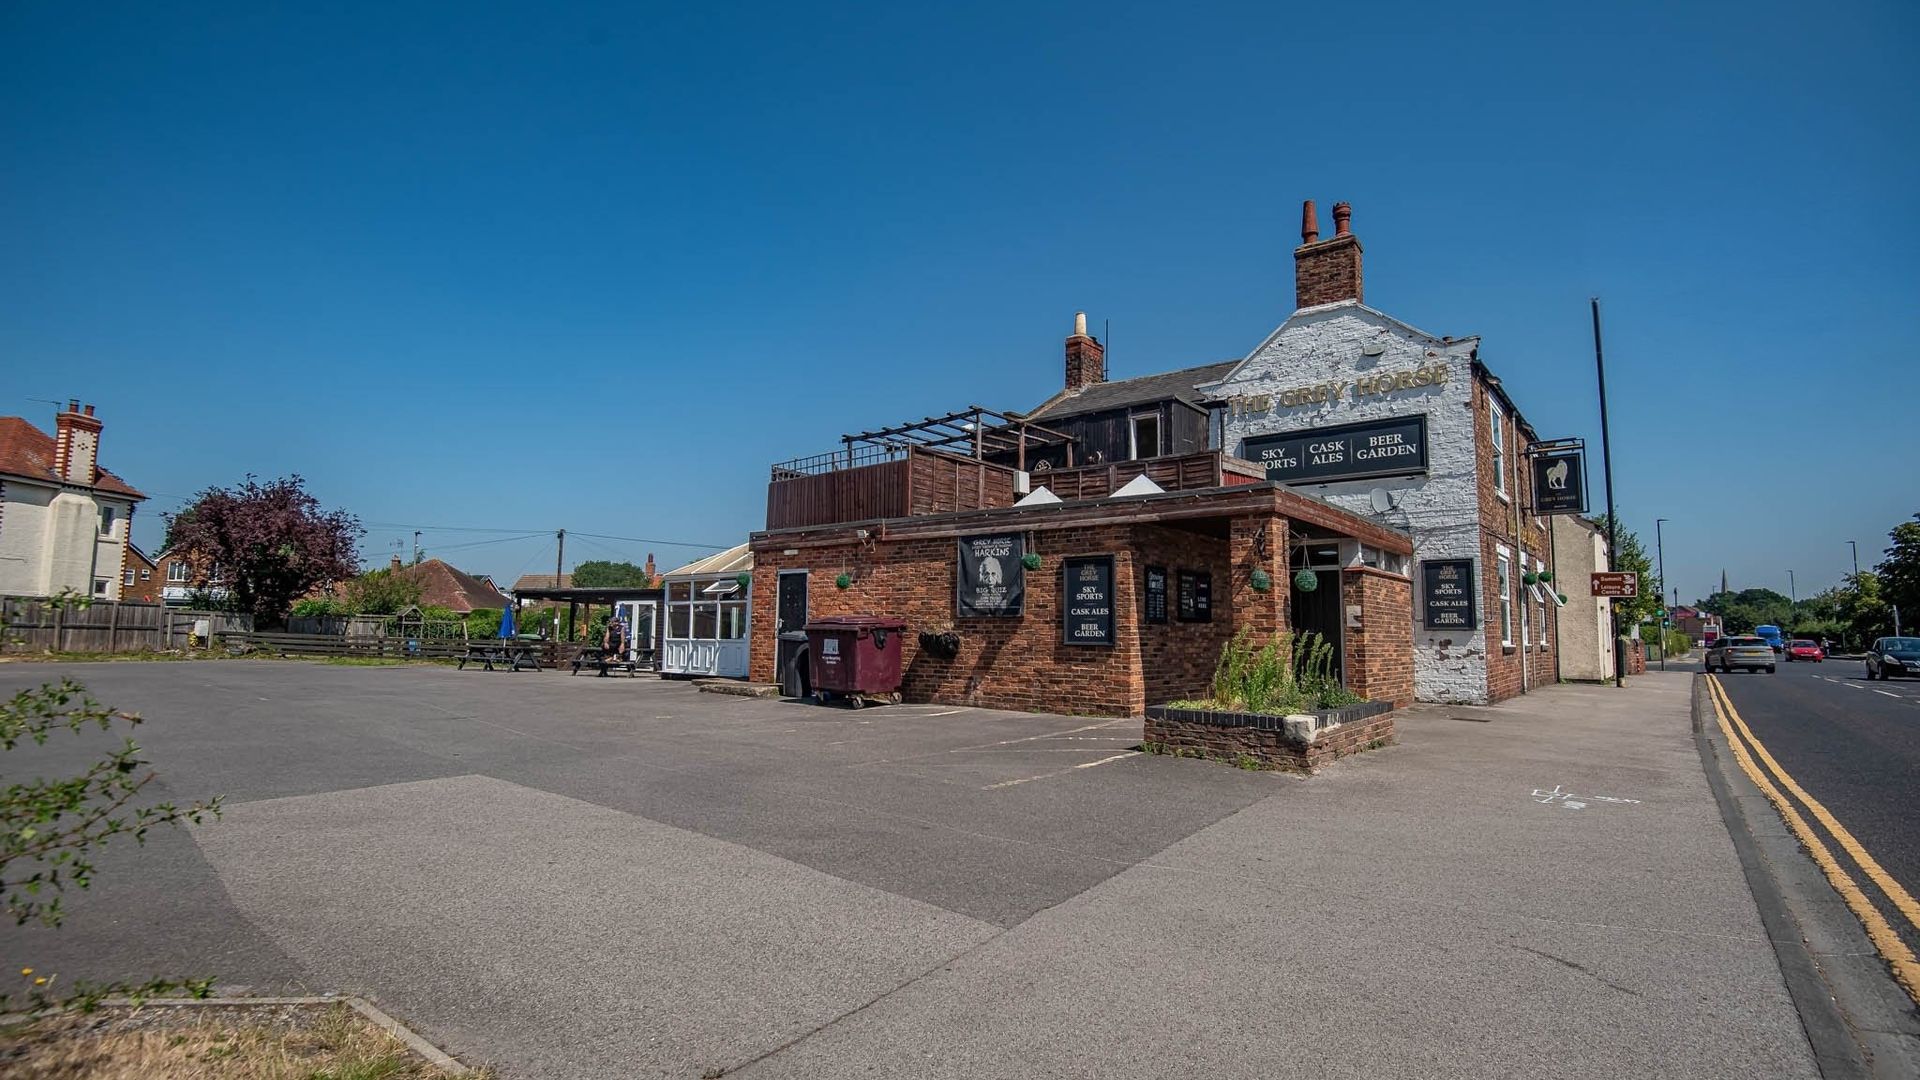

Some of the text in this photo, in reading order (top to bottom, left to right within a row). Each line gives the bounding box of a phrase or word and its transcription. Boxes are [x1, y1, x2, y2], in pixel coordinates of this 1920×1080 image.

[1229, 364, 1449, 416] THE GREY HORSE
[1310, 440, 1344, 454] CASK
[1369, 434, 1404, 447] BEER
[1262, 448, 1286, 460] SKY
[1312, 452, 1344, 465] ALES
[1356, 444, 1417, 460] GARDEN
[1258, 457, 1297, 470] PORTS
[974, 548, 1010, 558] HARKINS
